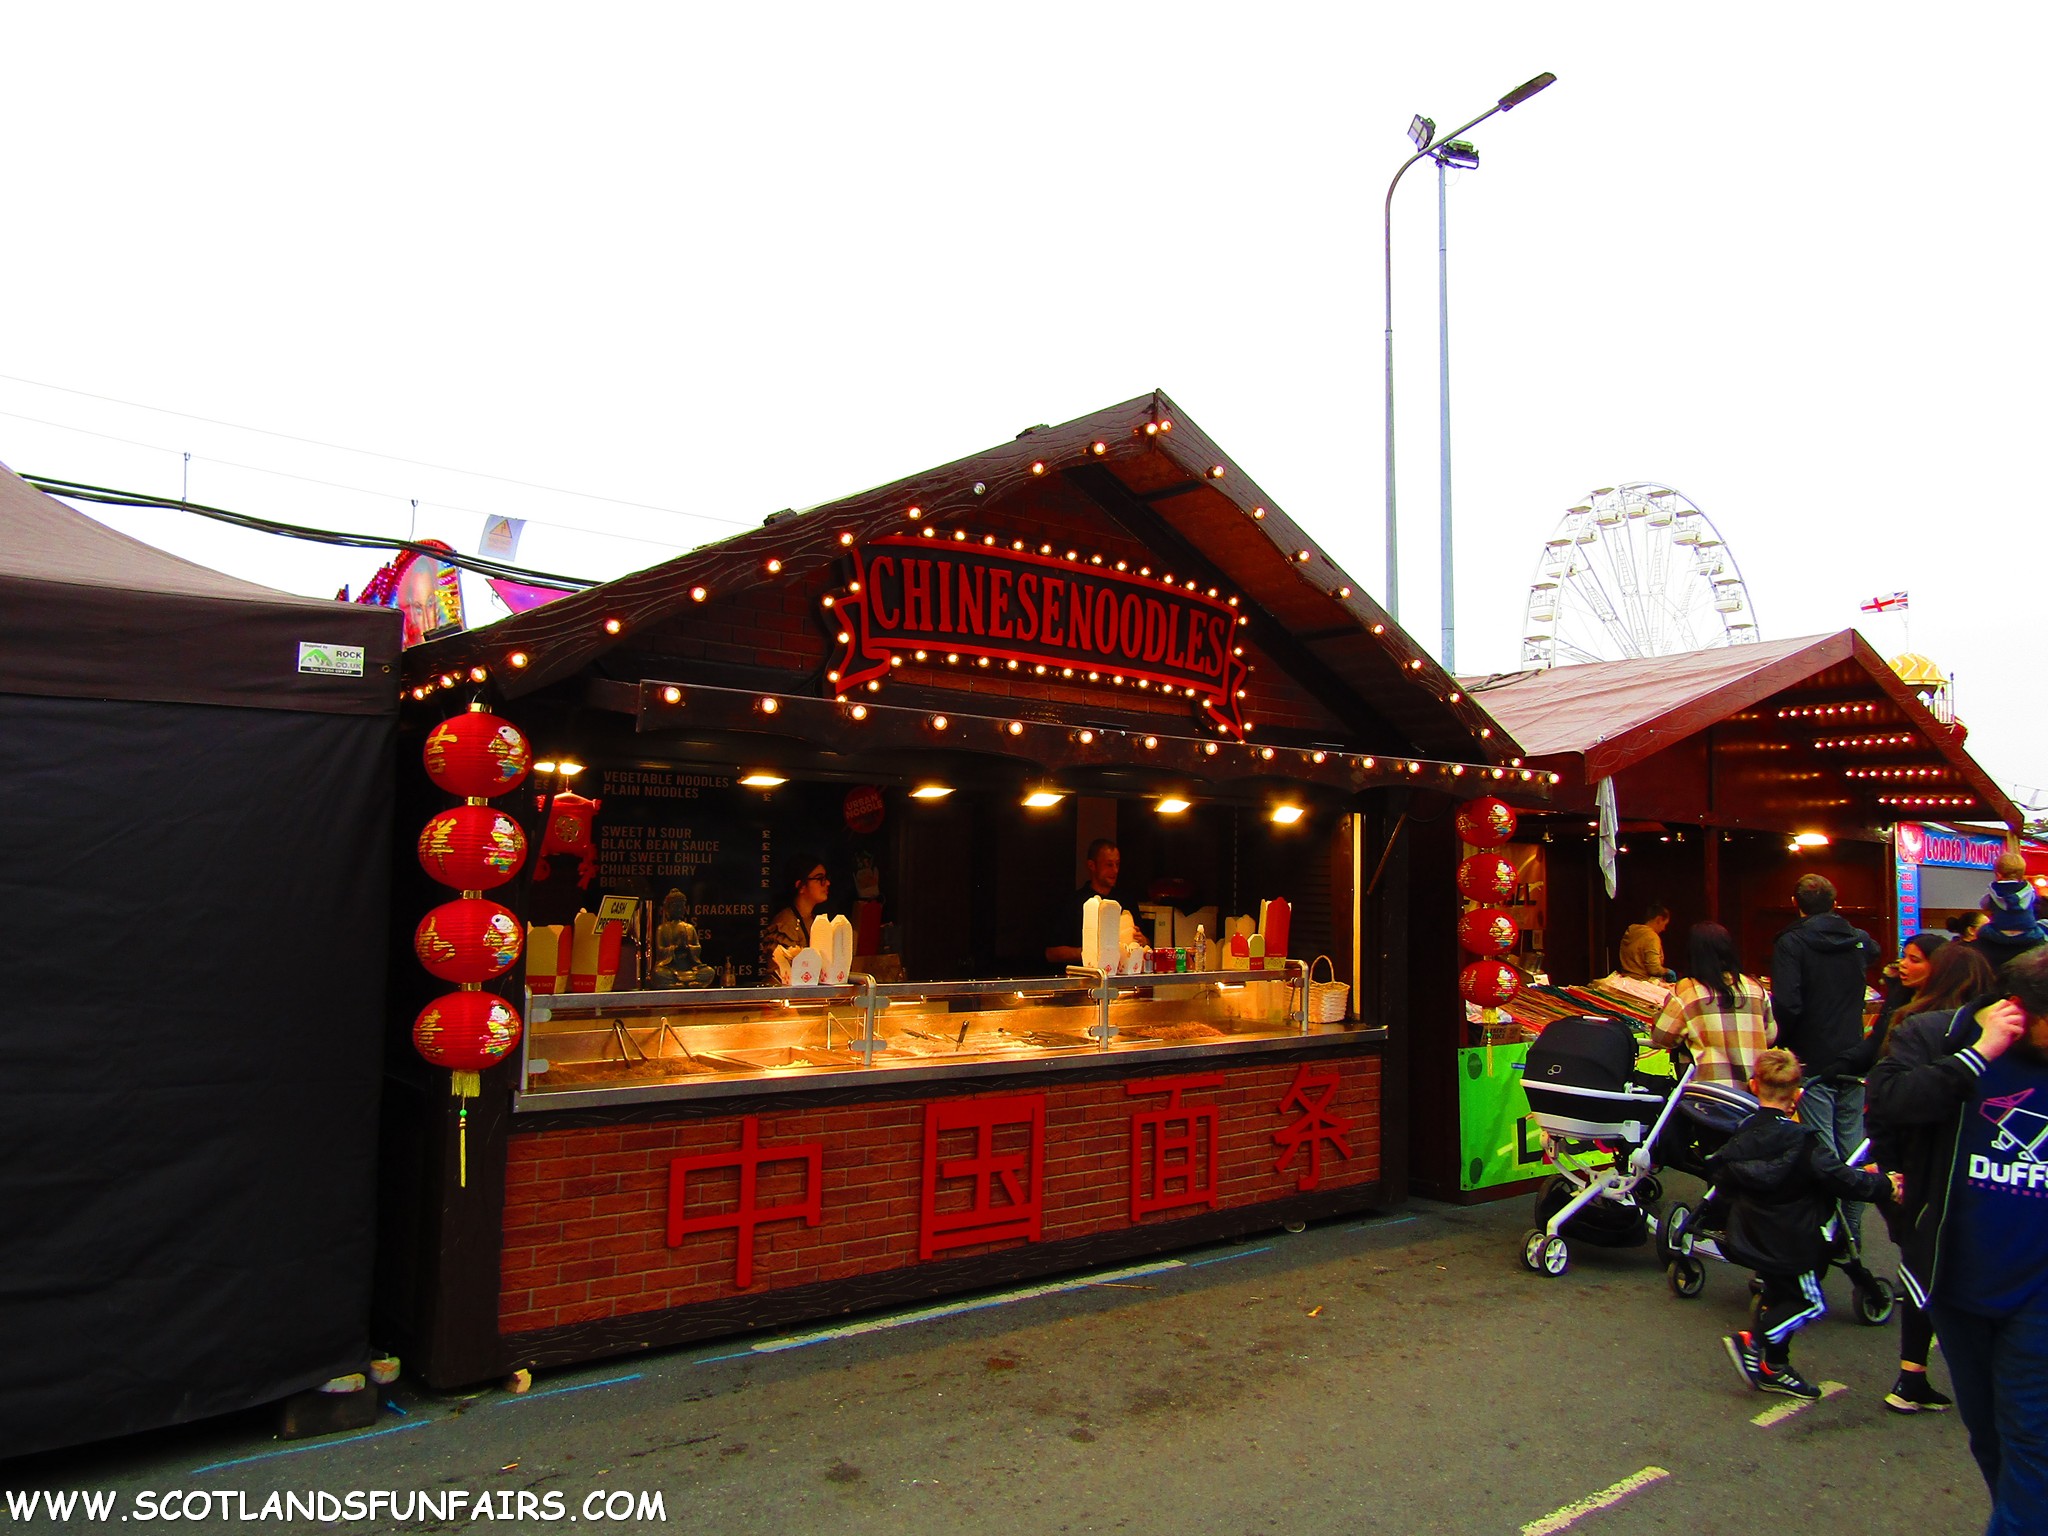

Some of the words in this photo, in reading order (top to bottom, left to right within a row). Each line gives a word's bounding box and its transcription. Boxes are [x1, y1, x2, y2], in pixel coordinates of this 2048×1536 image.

[336, 650, 362, 659] ROCK
[603, 771, 672, 786] VEGETABLE
[676, 775, 729, 788] NOODLES
[603, 783, 640, 796] PLAIN
[644, 786, 699, 799] NOODLES
[845, 799, 884, 819] NOODLE
[846, 793, 879, 811] URBAN
[601, 826, 644, 839] SWEET
[648, 827, 657, 838] N
[660, 827, 692, 839] SOUR
[601, 838, 642, 850] BLACK
[646, 839, 678, 851] BEAN
[682, 840, 720, 852] SAUCE
[1926, 834, 1963, 863] LOADED
[600, 851, 628, 863] HOT
[630, 851, 671, 863] SWEET
[674, 852, 713, 864] CHILLI
[600, 863, 654, 876] CHINESE
[657, 865, 697, 876] CURRY
[610, 901, 628, 914] CASH
[694, 904, 754, 915] CRACKERS
[1968, 1153, 2048, 1188] DuFF
